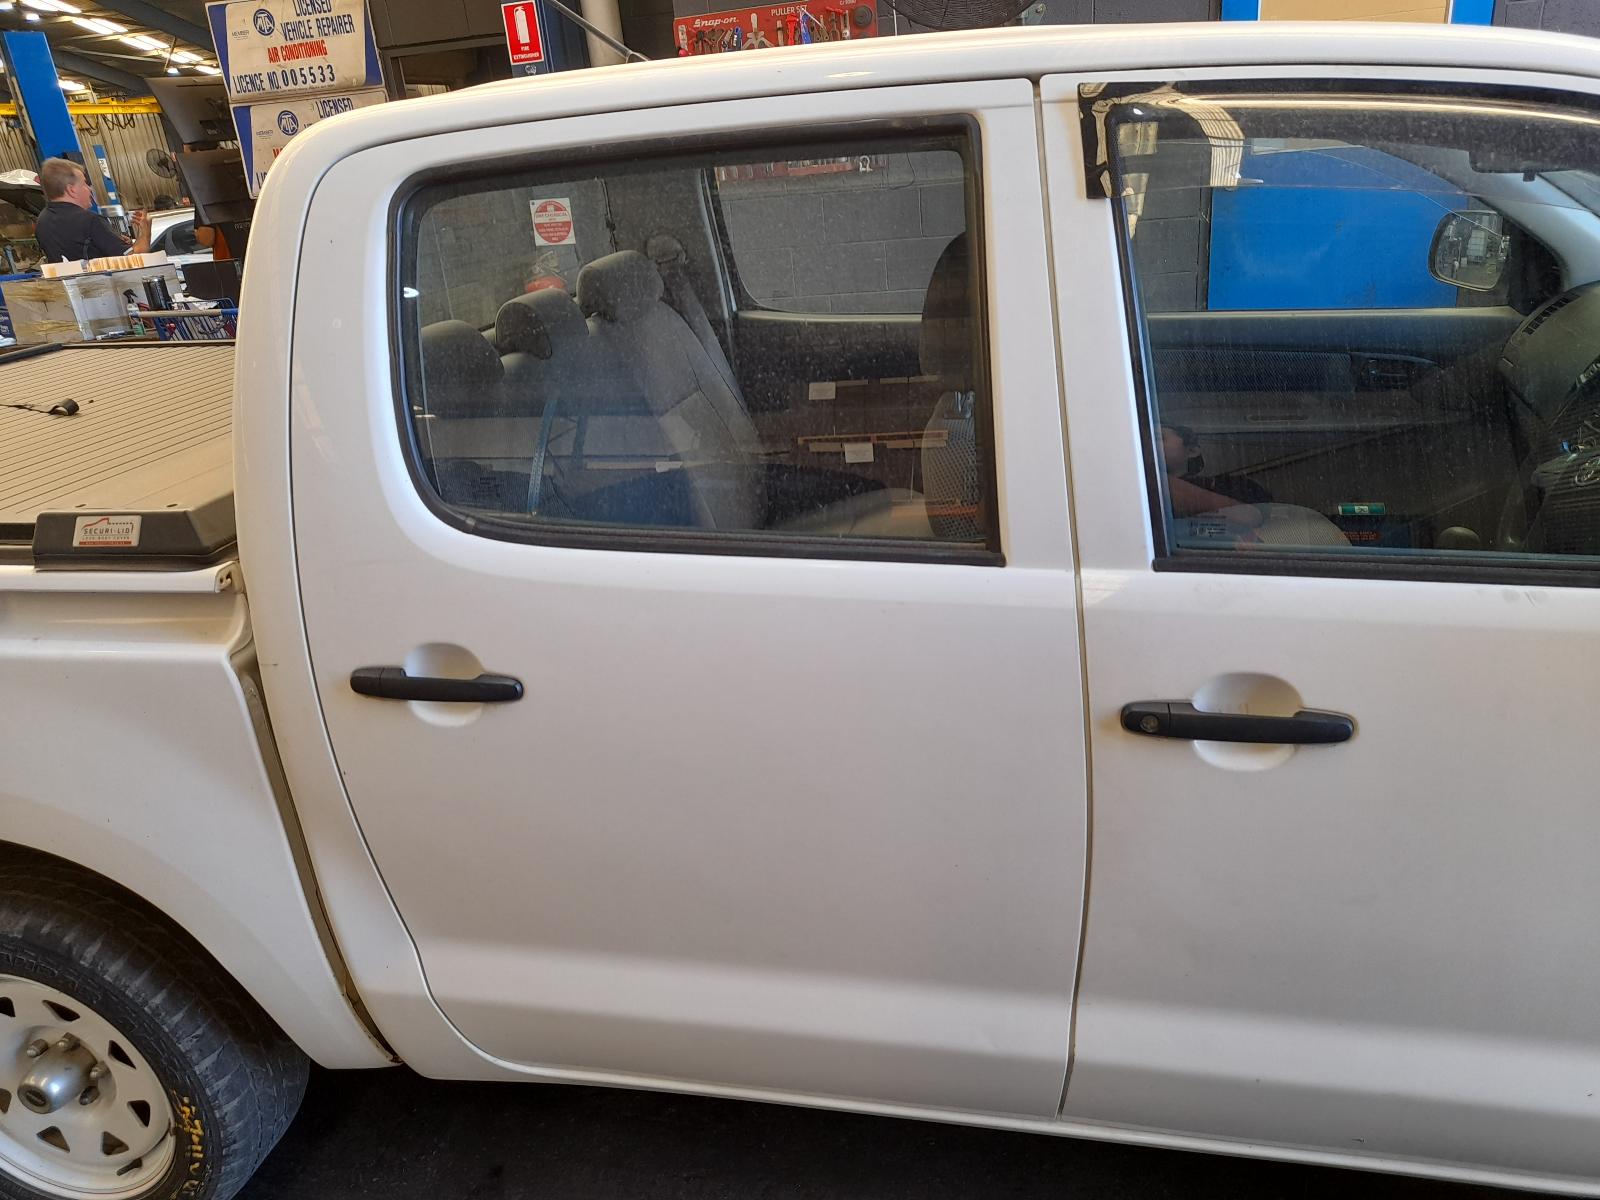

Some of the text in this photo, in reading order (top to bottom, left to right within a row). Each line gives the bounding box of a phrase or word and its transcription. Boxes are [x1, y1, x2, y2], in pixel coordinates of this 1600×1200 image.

[292, 0, 332, 16] LICENSED
[771, 6, 796, 17] PULLER
[281, 14, 355, 41] VEHICLE REPAIRER
[693, 16, 737, 28] Snap-on
[268, 40, 327, 63] AIR CONDITIONING
[233, 73, 265, 93] LICENCE
[267, 71, 281, 90] NO.
[282, 64, 335, 87] 005533
